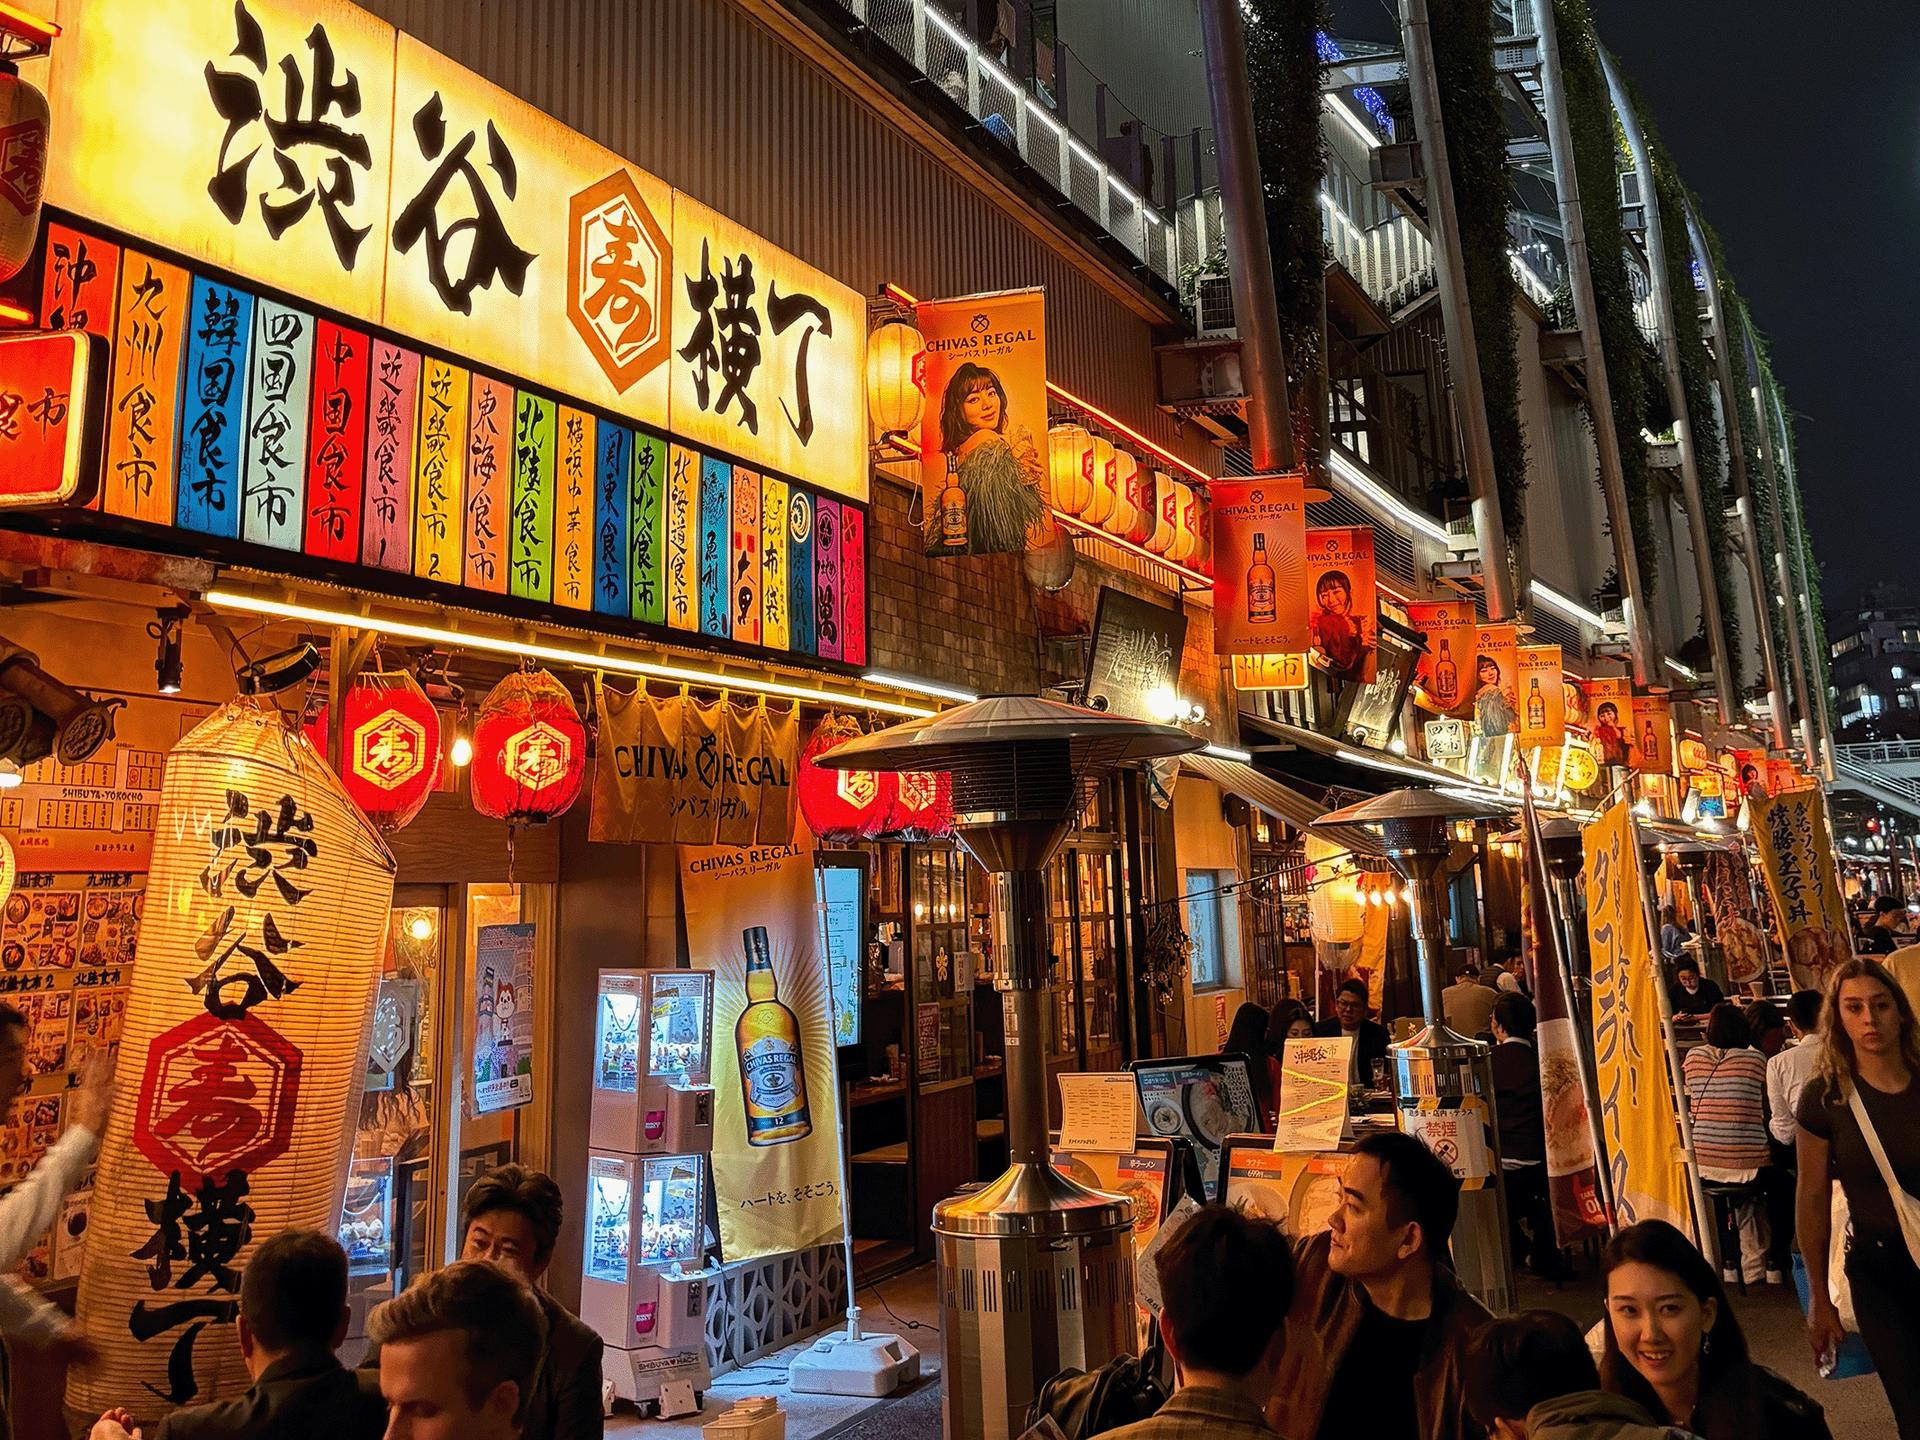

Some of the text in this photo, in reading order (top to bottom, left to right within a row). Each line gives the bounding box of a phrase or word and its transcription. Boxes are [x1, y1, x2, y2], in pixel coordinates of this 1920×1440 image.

[203, 0, 539, 316] 渋谷
[116, 261, 168, 515] 九州食市
[190, 286, 242, 531] 韓国食市
[246, 306, 303, 540] 四国食市
[926, 329, 1037, 353] CHIVAS REGAL
[312, 329, 354, 548] 中国食市
[468, 383, 501, 586] 東海食市
[513, 396, 546, 597] 北陸食市
[600, 428, 624, 609] 関東食市
[1218, 502, 1299, 517] CHIVAS REGAL
[632, 438, 657, 616] 東北食市
[670, 451, 692, 623] 北海道食市
[1335, 551, 1369, 561] REGAL
[1444, 618, 1473, 626] REGAL
[1488, 640, 1514, 648] REGAL
[614, 745, 791, 788] CHIVAS REGAL
[183, 786, 319, 1022] 渋谷
[689, 842, 805, 874] CHIVAS REGAL
[746, 1053, 797, 1072] CHIVAS REGAL
[774, 1117, 785, 1126] 12
[1592, 848, 1637, 1224] タコライス
[1426, 1121, 1458, 1137] 禁煙
